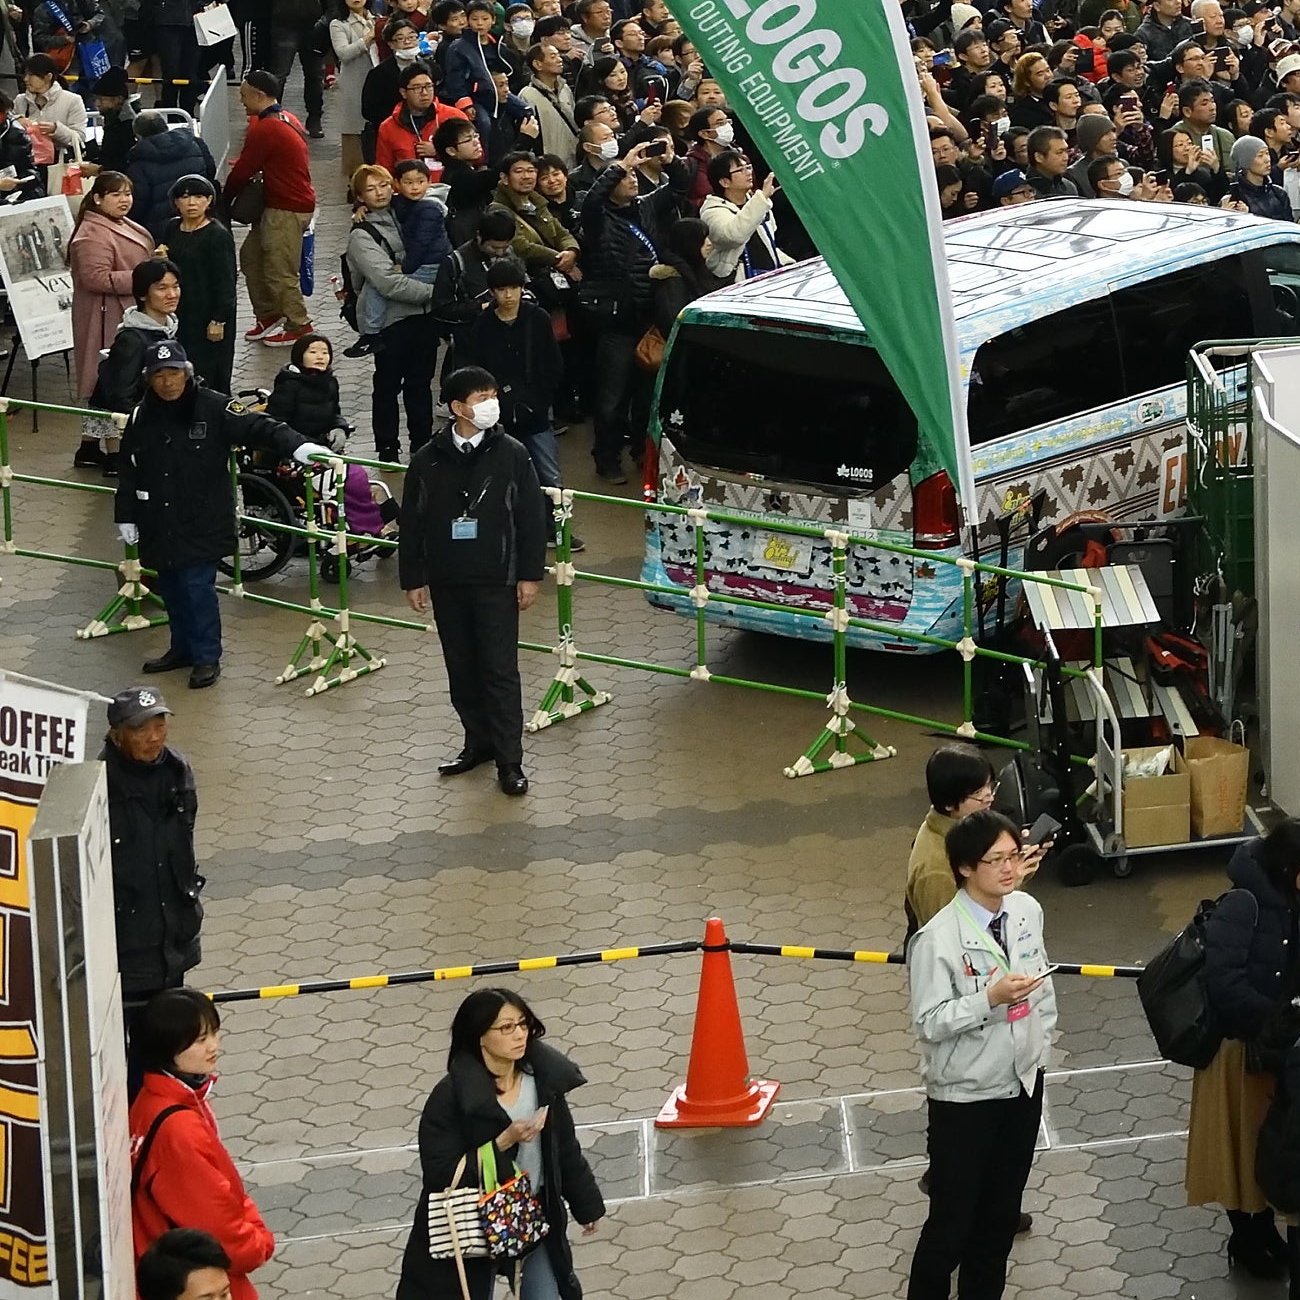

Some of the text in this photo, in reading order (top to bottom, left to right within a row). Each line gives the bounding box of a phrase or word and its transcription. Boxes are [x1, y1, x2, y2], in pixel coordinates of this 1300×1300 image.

[689, 0, 825, 182] OUTING EQUIPMENT
[850, 466, 873, 478] LOGOS
